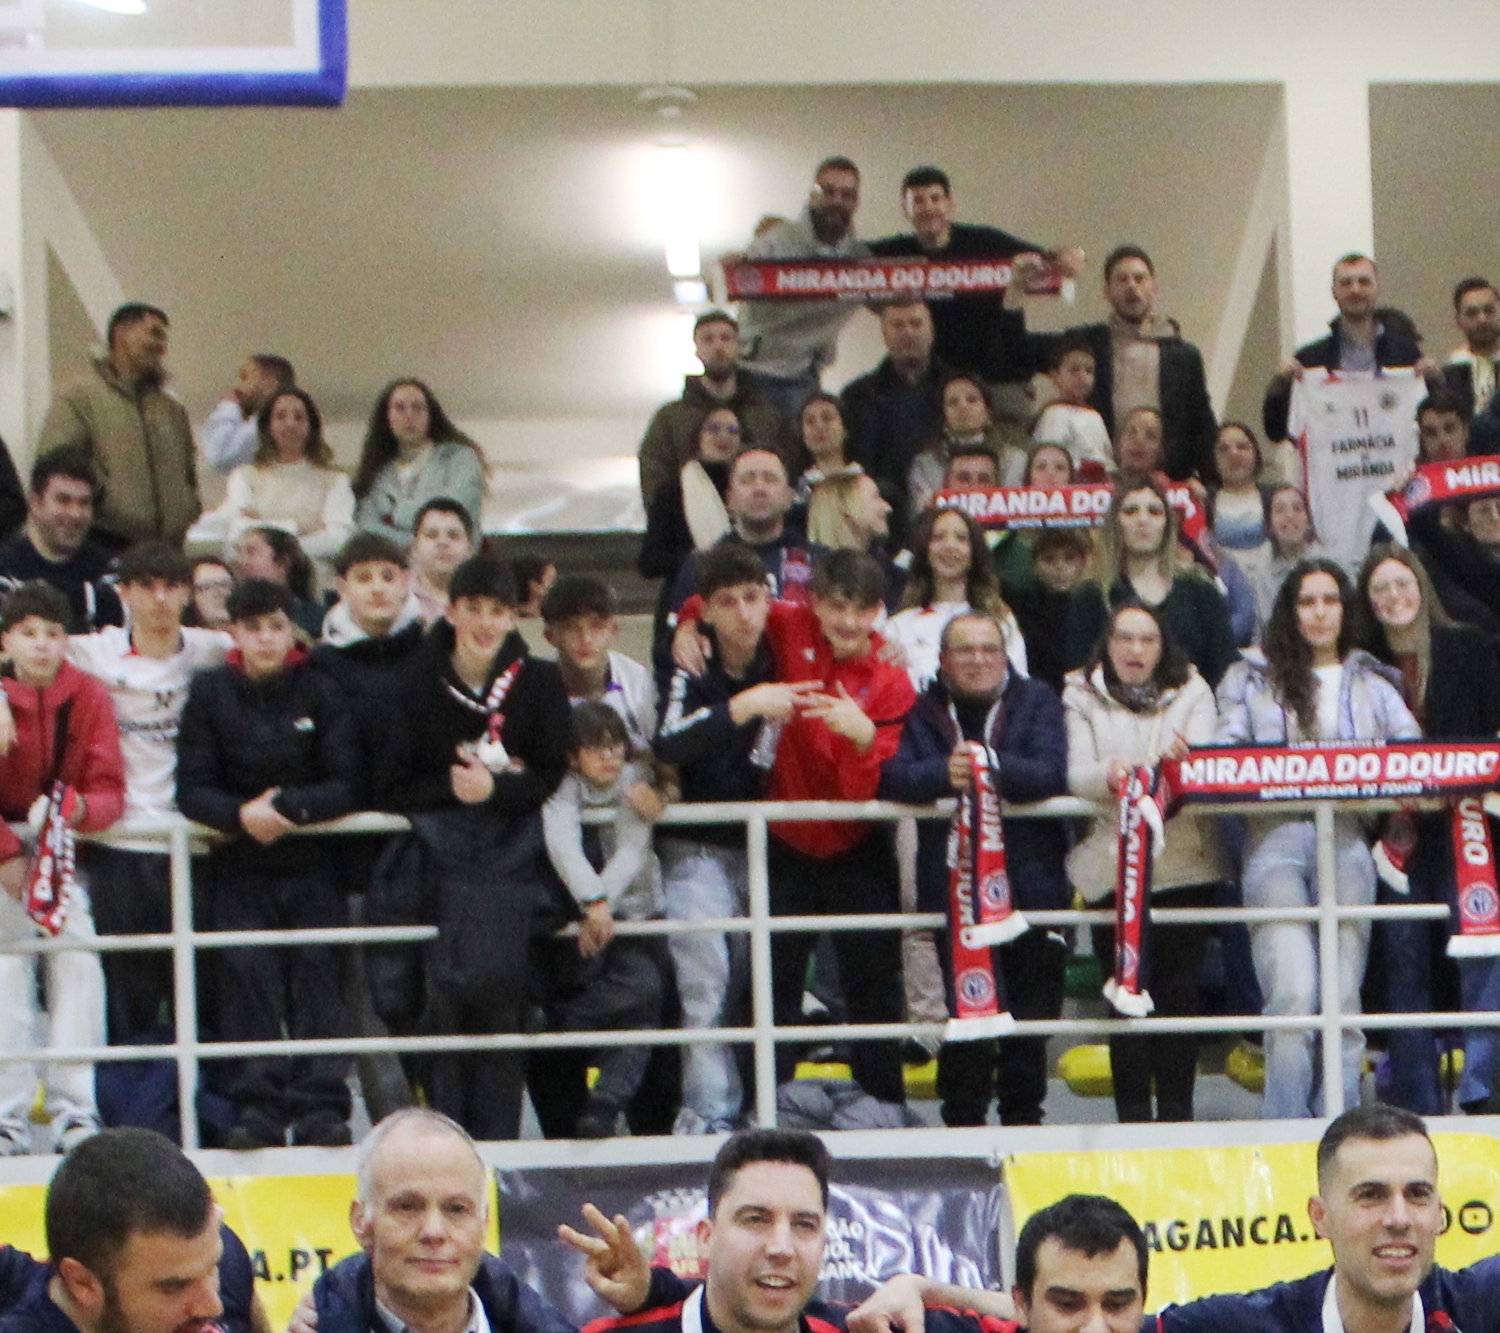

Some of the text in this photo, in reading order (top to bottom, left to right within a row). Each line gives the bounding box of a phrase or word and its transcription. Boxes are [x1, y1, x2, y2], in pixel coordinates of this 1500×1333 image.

[775, 265, 1012, 289] MIRANDA DO DOURO
[1336, 461, 1395, 480] MIRANDA
[1071, 489, 1112, 514] DO
[1180, 751, 1500, 785] MIRANDA DO DOURO
